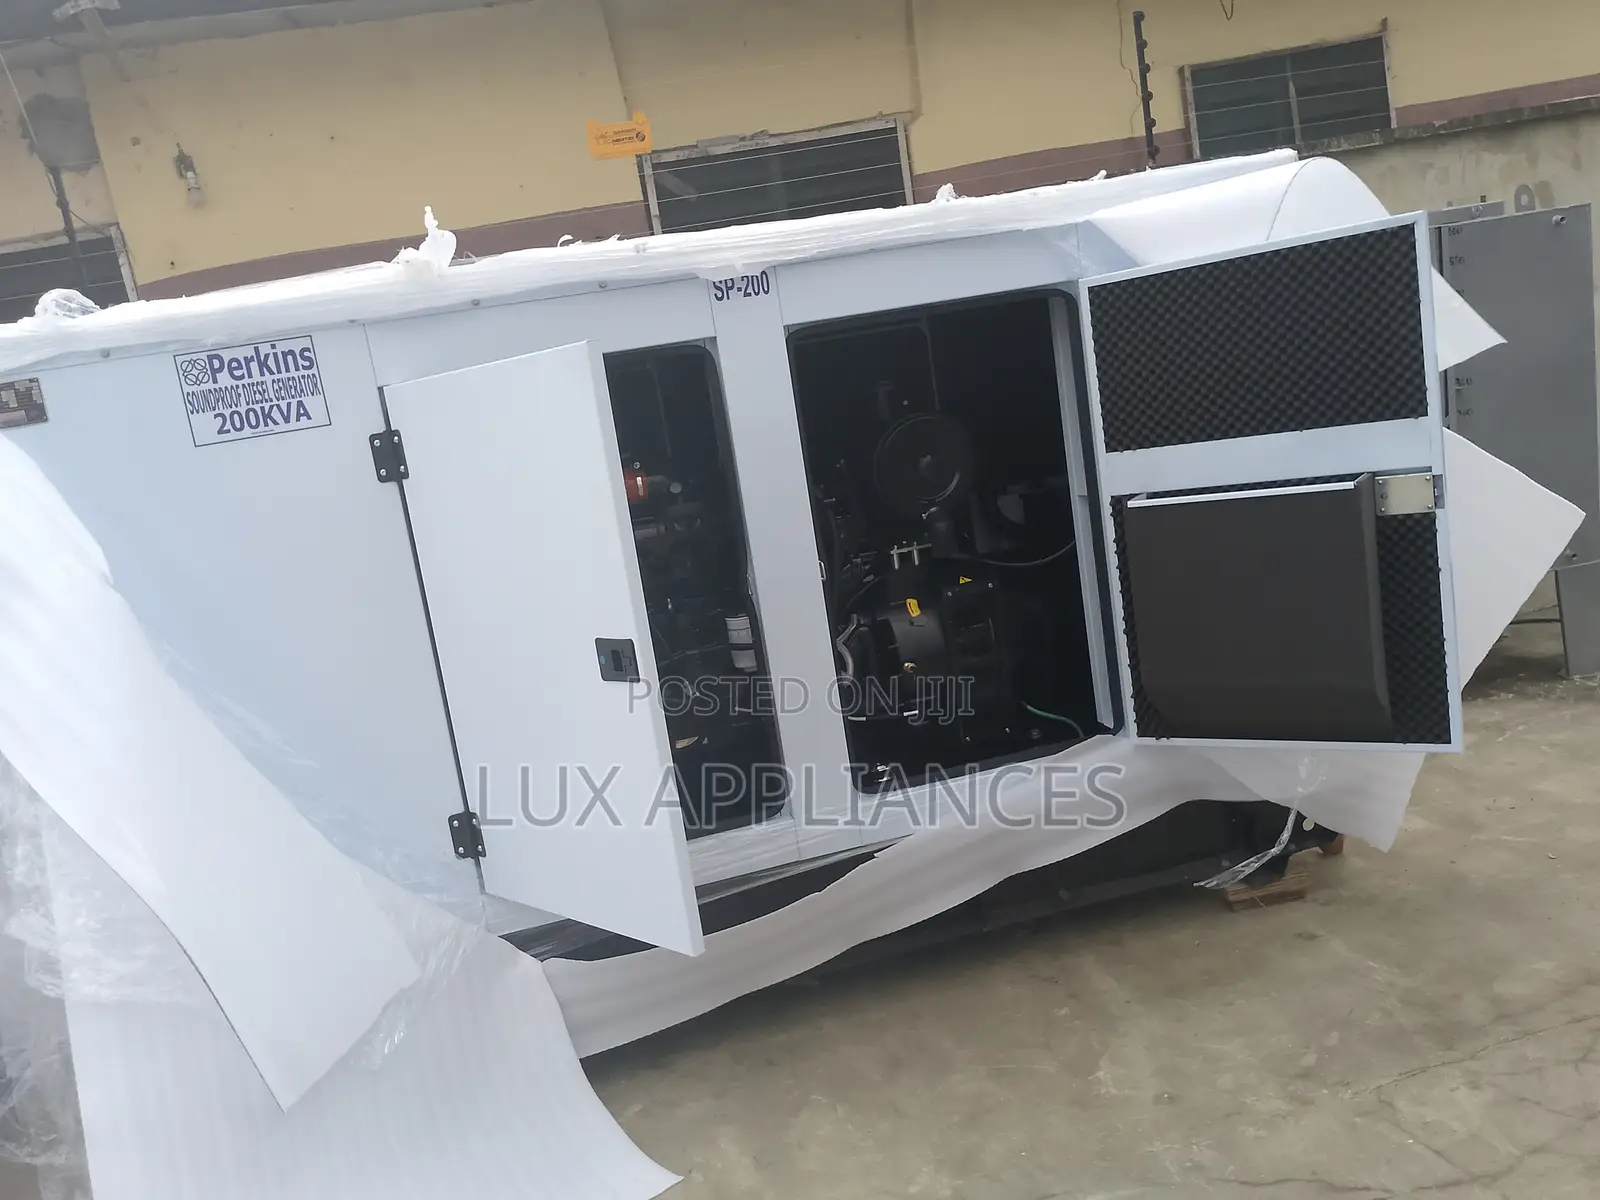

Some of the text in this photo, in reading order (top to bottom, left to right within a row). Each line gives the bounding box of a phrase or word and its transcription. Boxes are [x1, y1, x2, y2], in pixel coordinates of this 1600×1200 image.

[712, 270, 770, 302] SP-200
[206, 344, 315, 385] Perkins
[186, 373, 322, 415] SOUNDPROOF DIESEL GENERATOR
[213, 399, 312, 435] 200KVA
